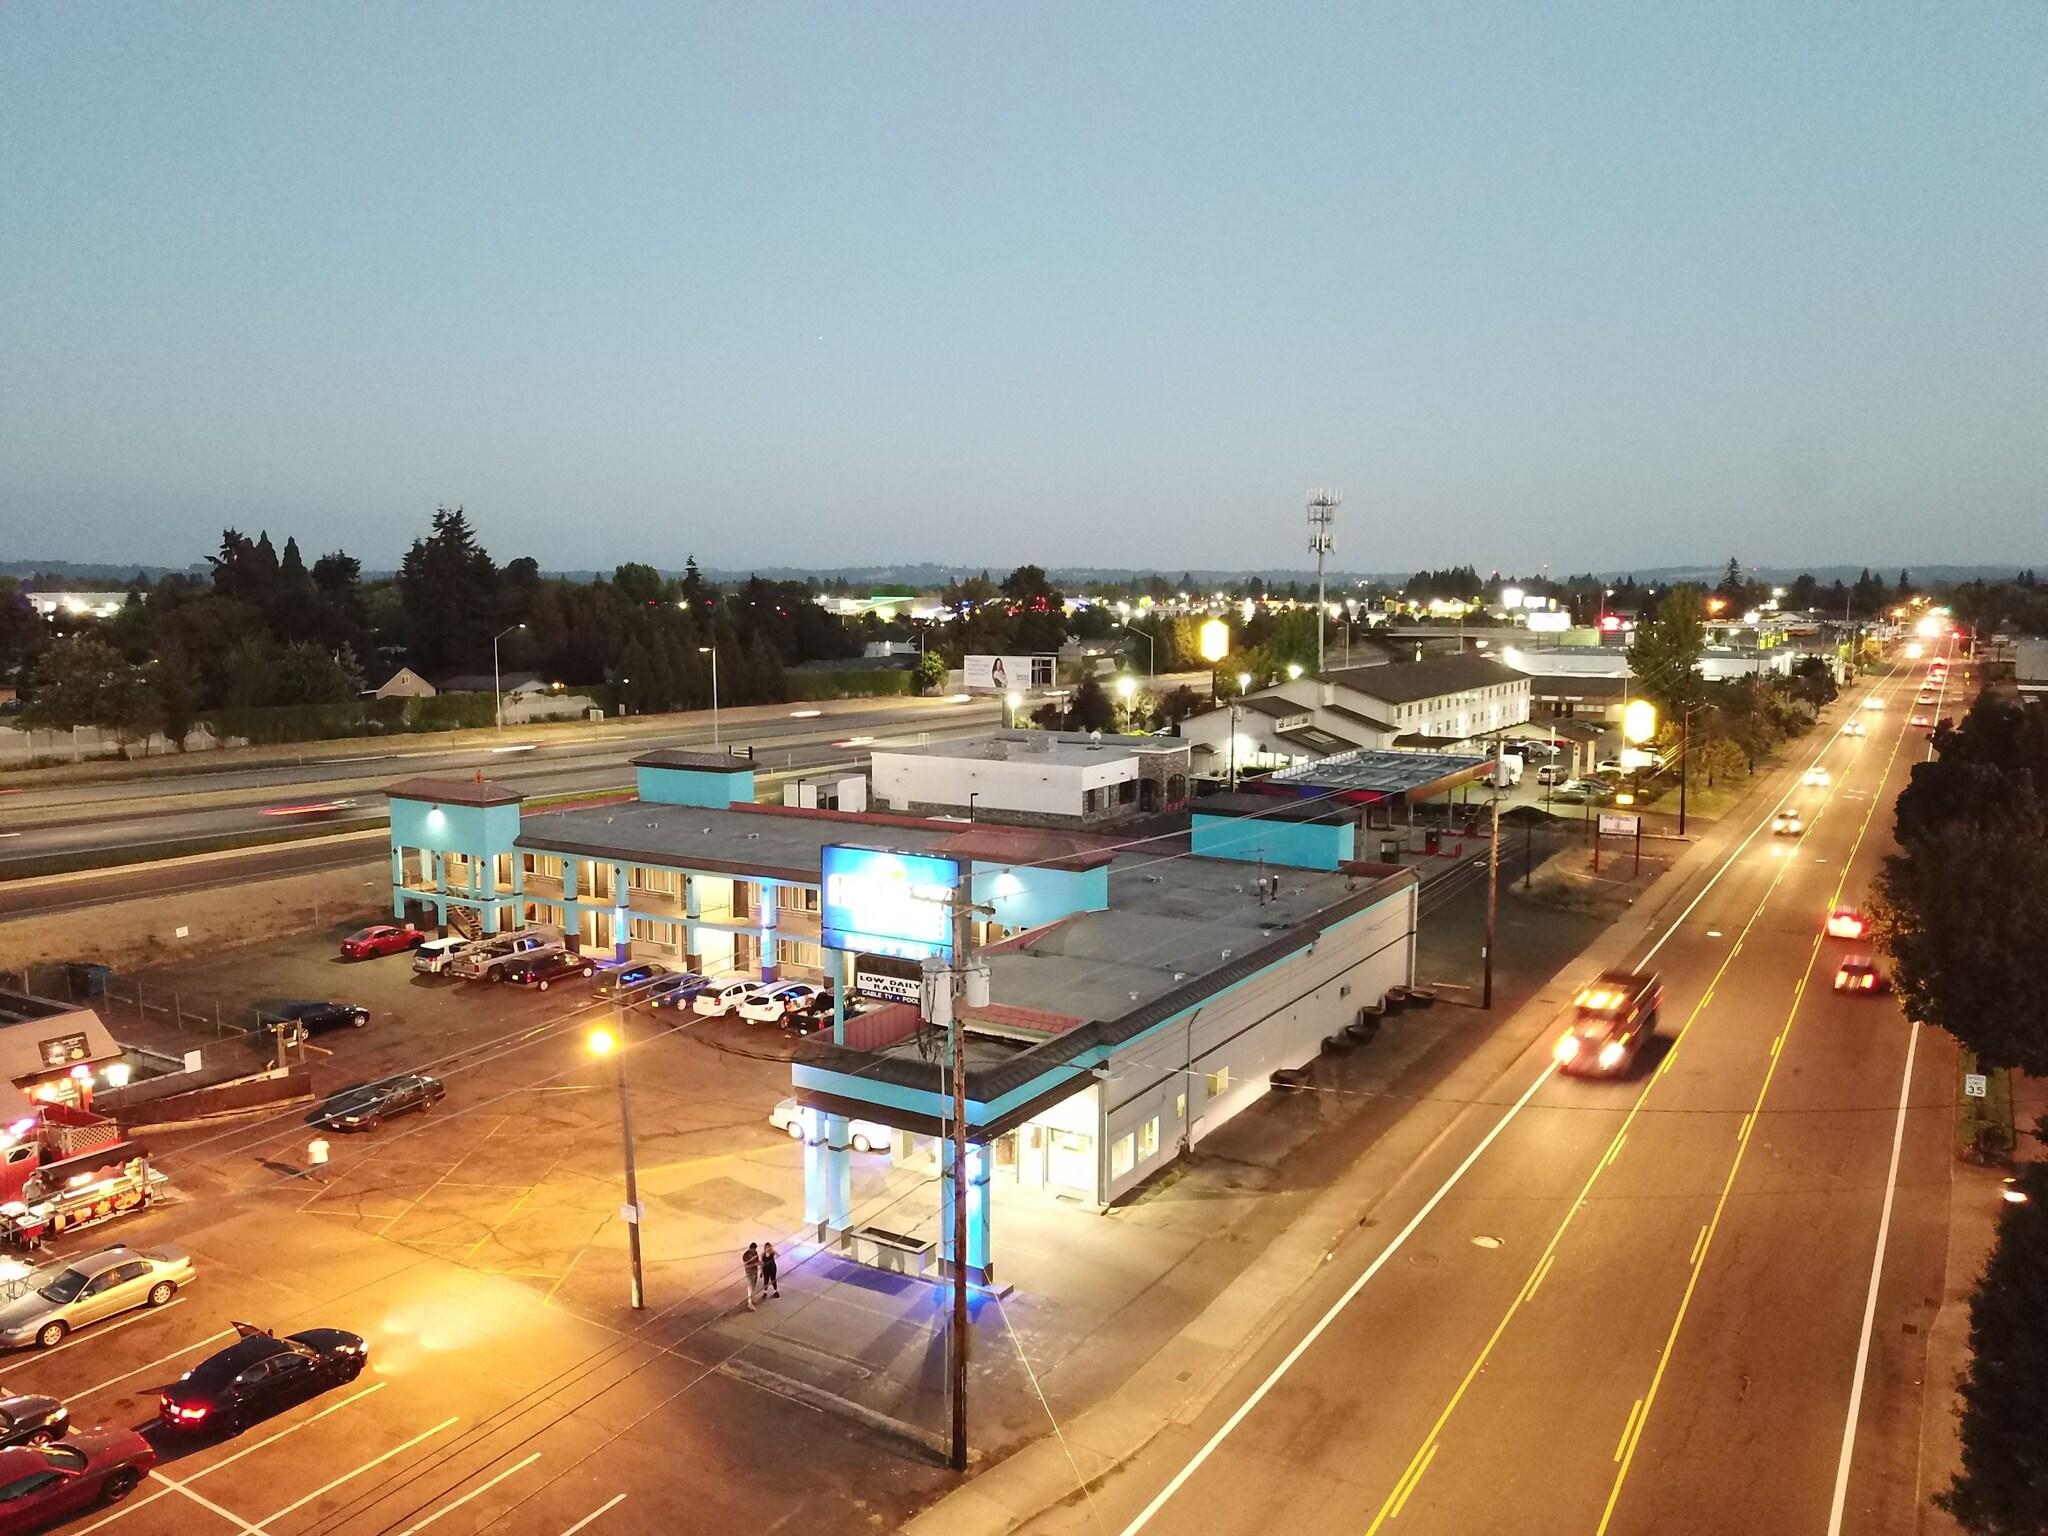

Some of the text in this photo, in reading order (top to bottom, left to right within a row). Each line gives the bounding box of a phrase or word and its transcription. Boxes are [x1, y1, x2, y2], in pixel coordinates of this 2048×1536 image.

[860, 975, 920, 990] LOW DAILY
[862, 990, 882, 998] CABLE
[874, 984, 907, 994] RATES
[1968, 1085, 1984, 1095] 35
